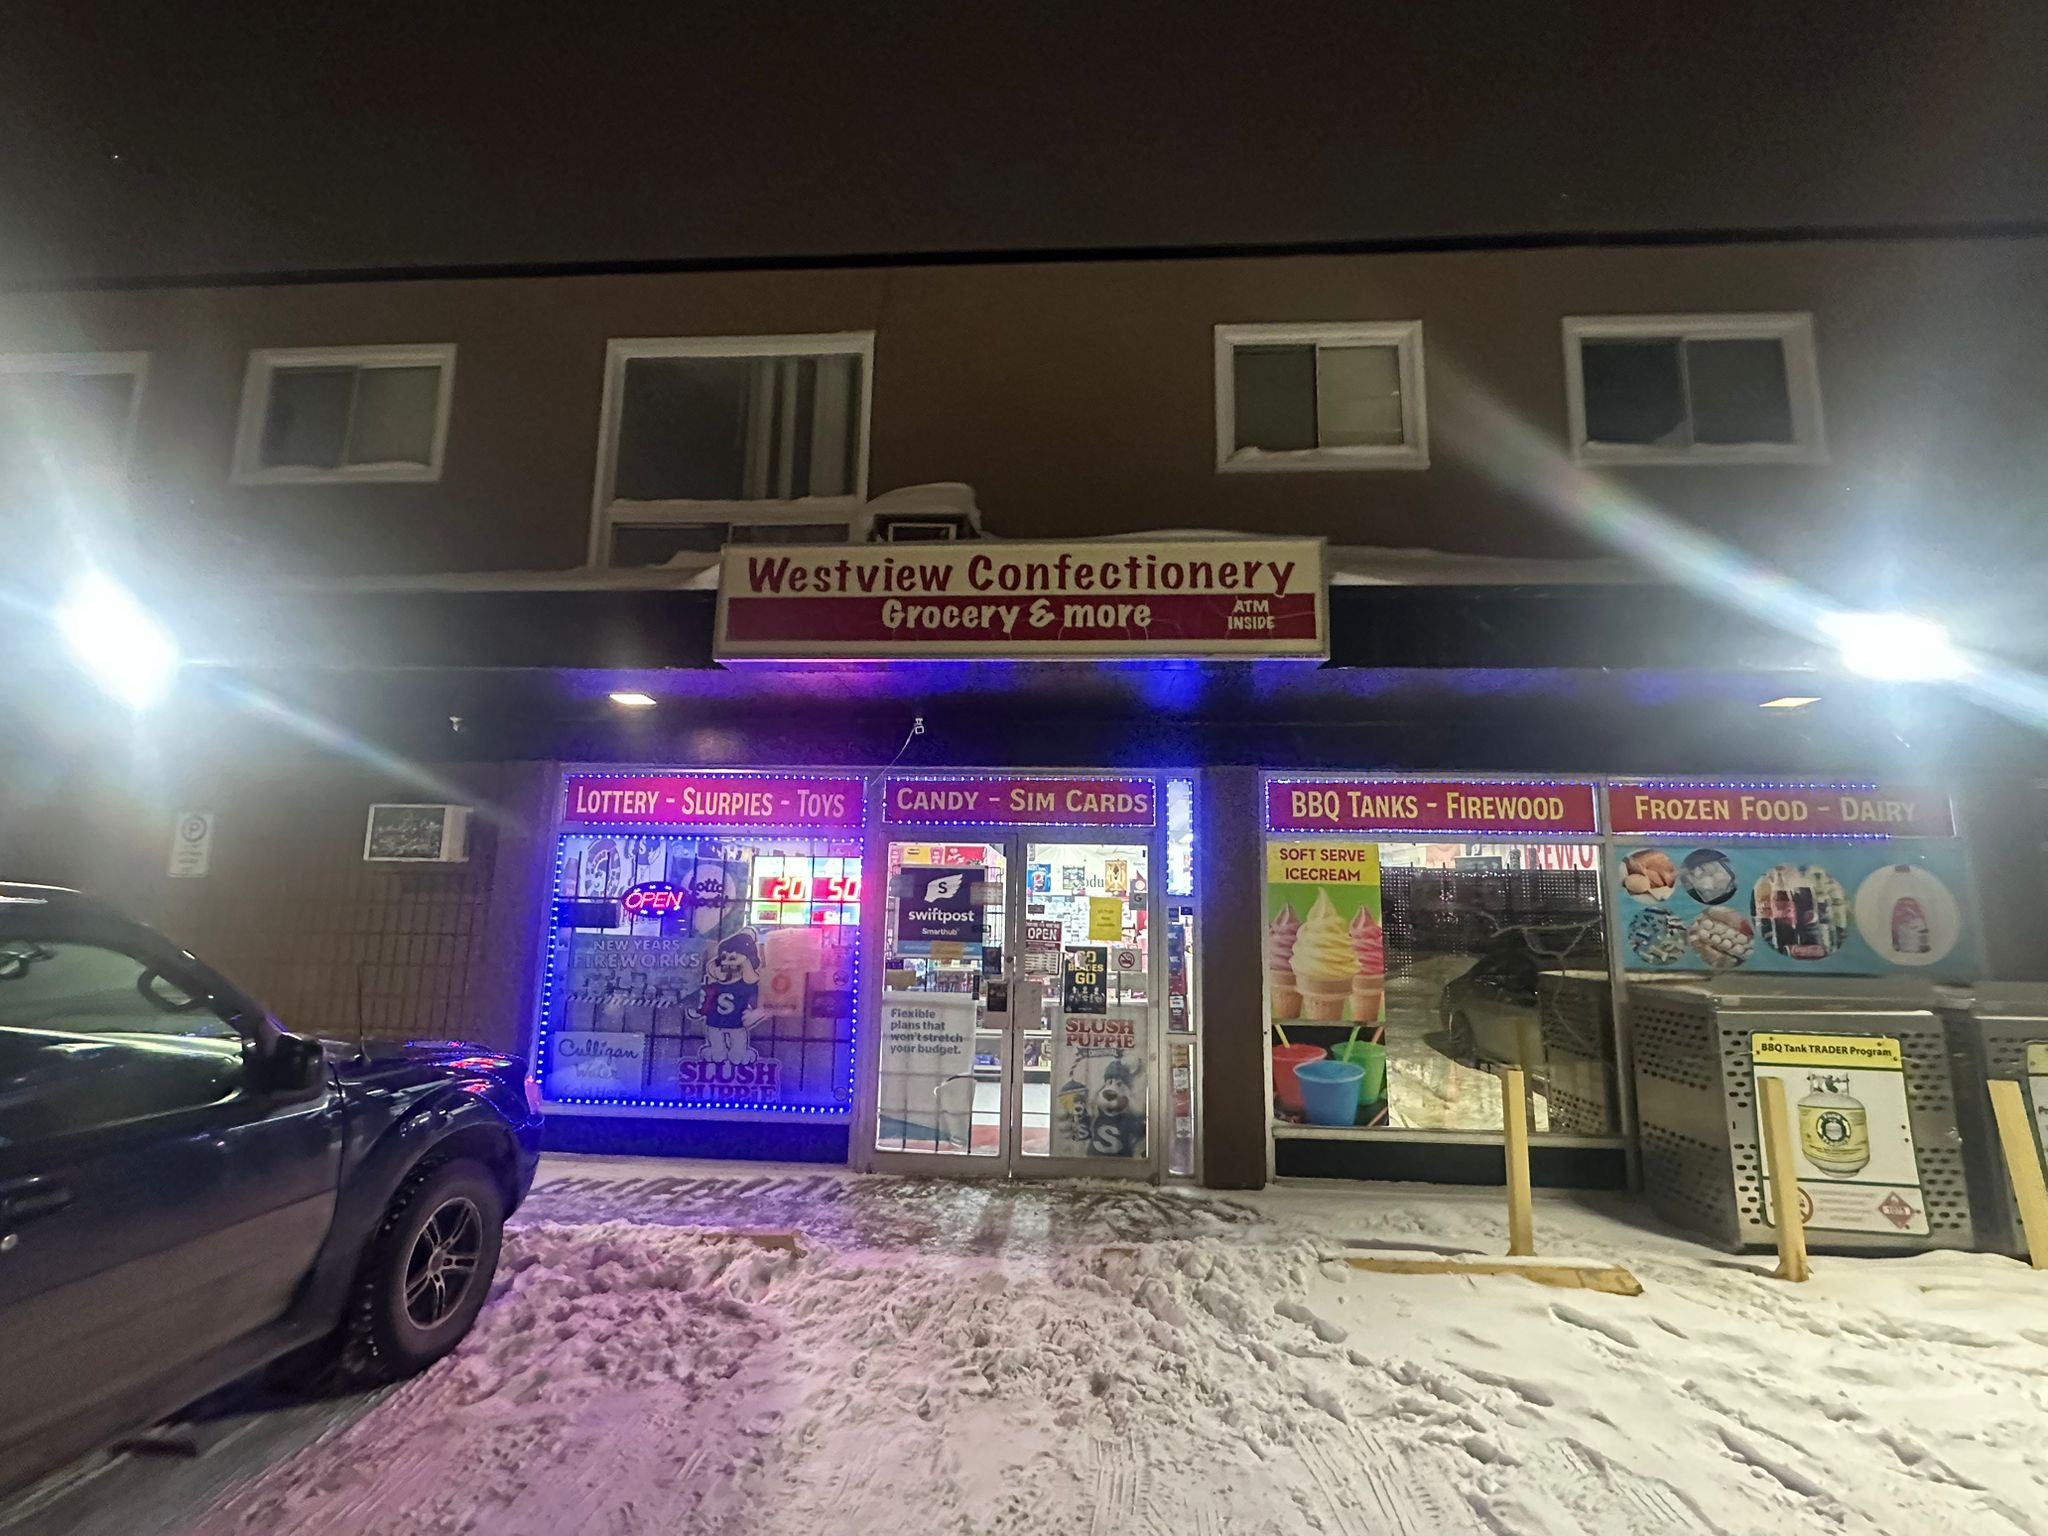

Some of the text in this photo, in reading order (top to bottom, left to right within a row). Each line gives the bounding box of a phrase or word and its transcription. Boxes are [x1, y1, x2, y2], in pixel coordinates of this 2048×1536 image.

[748, 554, 1295, 597] Westview Confectionery
[1232, 599, 1270, 614] ATM
[881, 598, 1152, 635] Grocery & more
[1227, 615, 1276, 631] INSIDE
[576, 786, 659, 815] LOTTERY
[682, 787, 773, 816] SLURPIES
[797, 789, 845, 818] TOYS
[896, 787, 979, 812] CANDY
[1009, 788, 1056, 812] SIM
[1065, 789, 1148, 814] CARDS
[1291, 790, 1340, 821] BBQ
[1346, 791, 1419, 819] TANKS
[1446, 791, 1564, 820] FIREWOOD
[1635, 795, 1730, 820] FROZEN
[1741, 796, 1808, 821] FOOD
[1841, 797, 1918, 823] DAIRY
[1280, 848, 1366, 863] SOFT SERVE
[1285, 868, 1361, 882] ICECREAM
[771, 876, 807, 899] 20
[827, 877, 861, 900] 50
[625, 891, 684, 909] OPEN
[908, 907, 975, 924] swiftpost
[1027, 927, 1058, 941] OPEN
[594, 940, 680, 951] NEW YEARS
[574, 953, 700, 968] FIREWORKS
[1075, 972, 1097, 985] GO
[890, 1008, 936, 1019] Flexible
[890, 1020, 946, 1031] plans that
[1065, 1018, 1135, 1035] SLUSH
[922, 1032, 963, 1043] stretch
[558, 1038, 639, 1067] Culligan
[890, 1044, 961, 1056] your budget.
[1761, 1043, 1893, 1058] BBQ Tank TRADER Program
[679, 1061, 778, 1084] SLUSH
